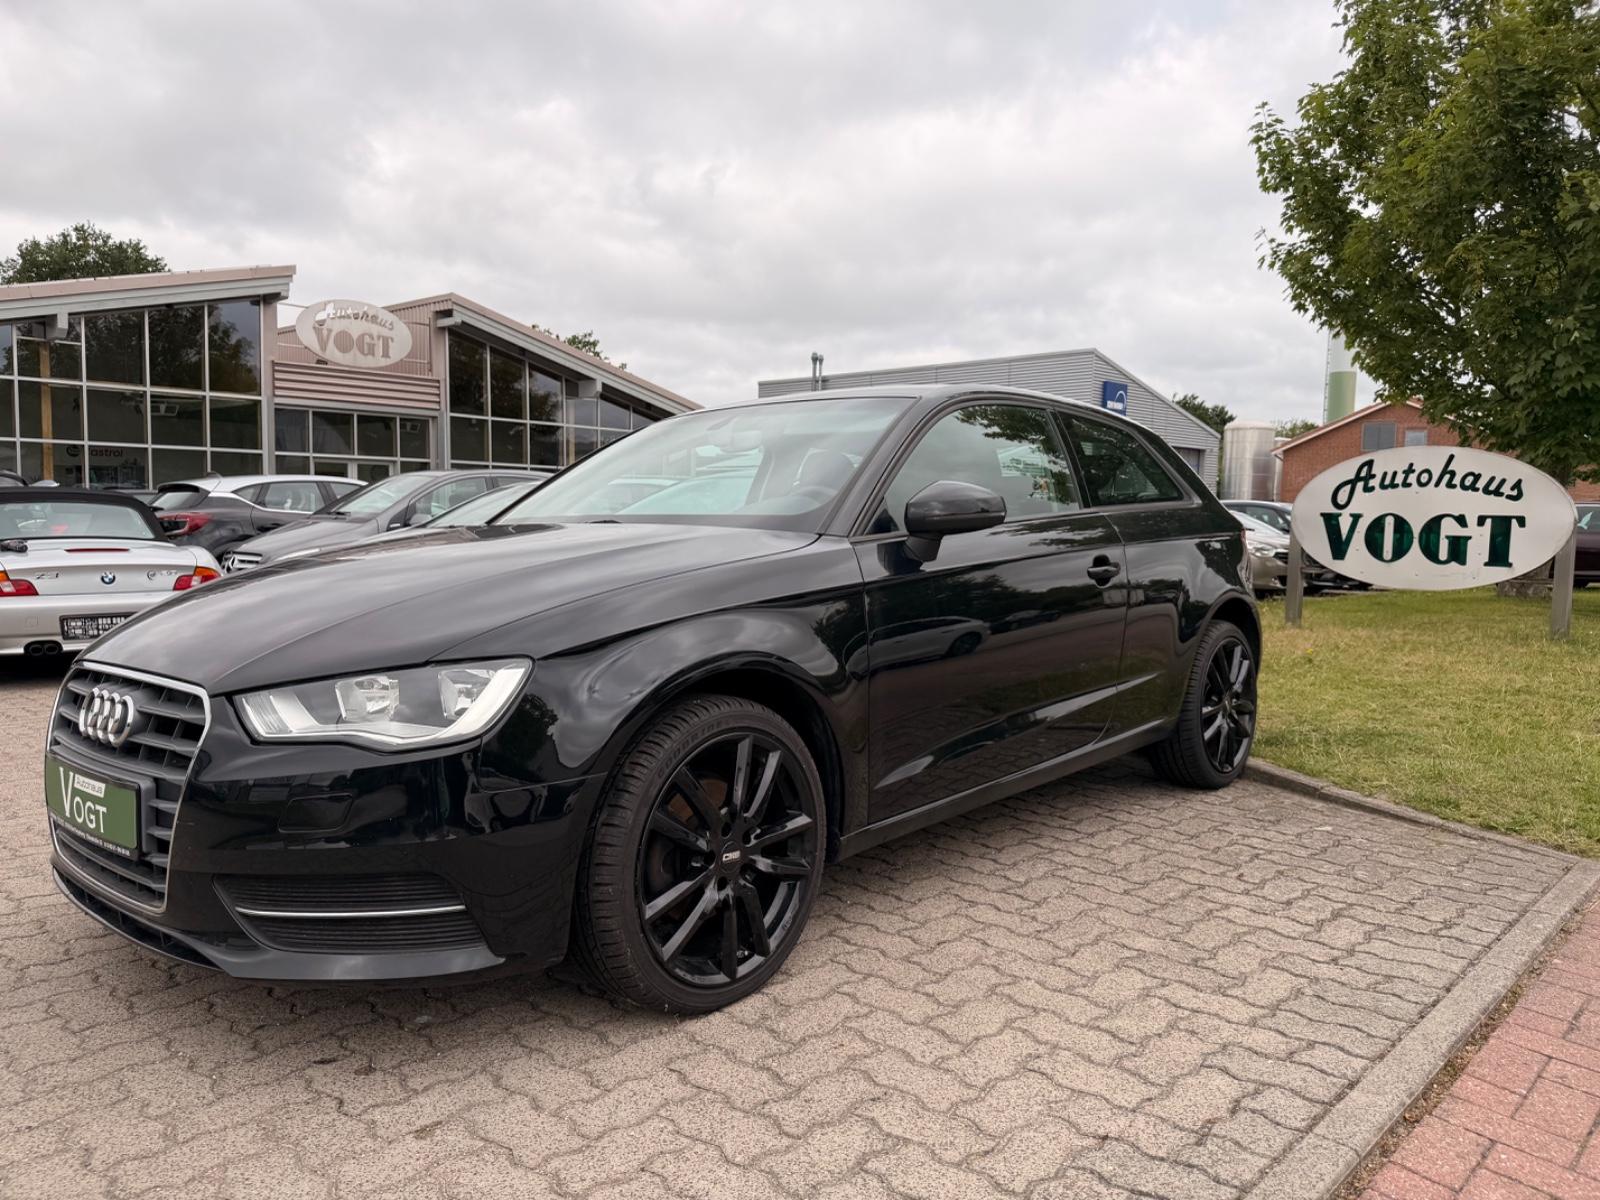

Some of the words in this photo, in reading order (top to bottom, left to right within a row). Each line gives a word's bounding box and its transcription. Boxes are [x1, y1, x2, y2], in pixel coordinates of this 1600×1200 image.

[315, 302, 394, 331] Autohaus
[312, 326, 395, 359] VOGT
[1331, 453, 1524, 510] Autohaus
[1320, 512, 1526, 567] VOGT
